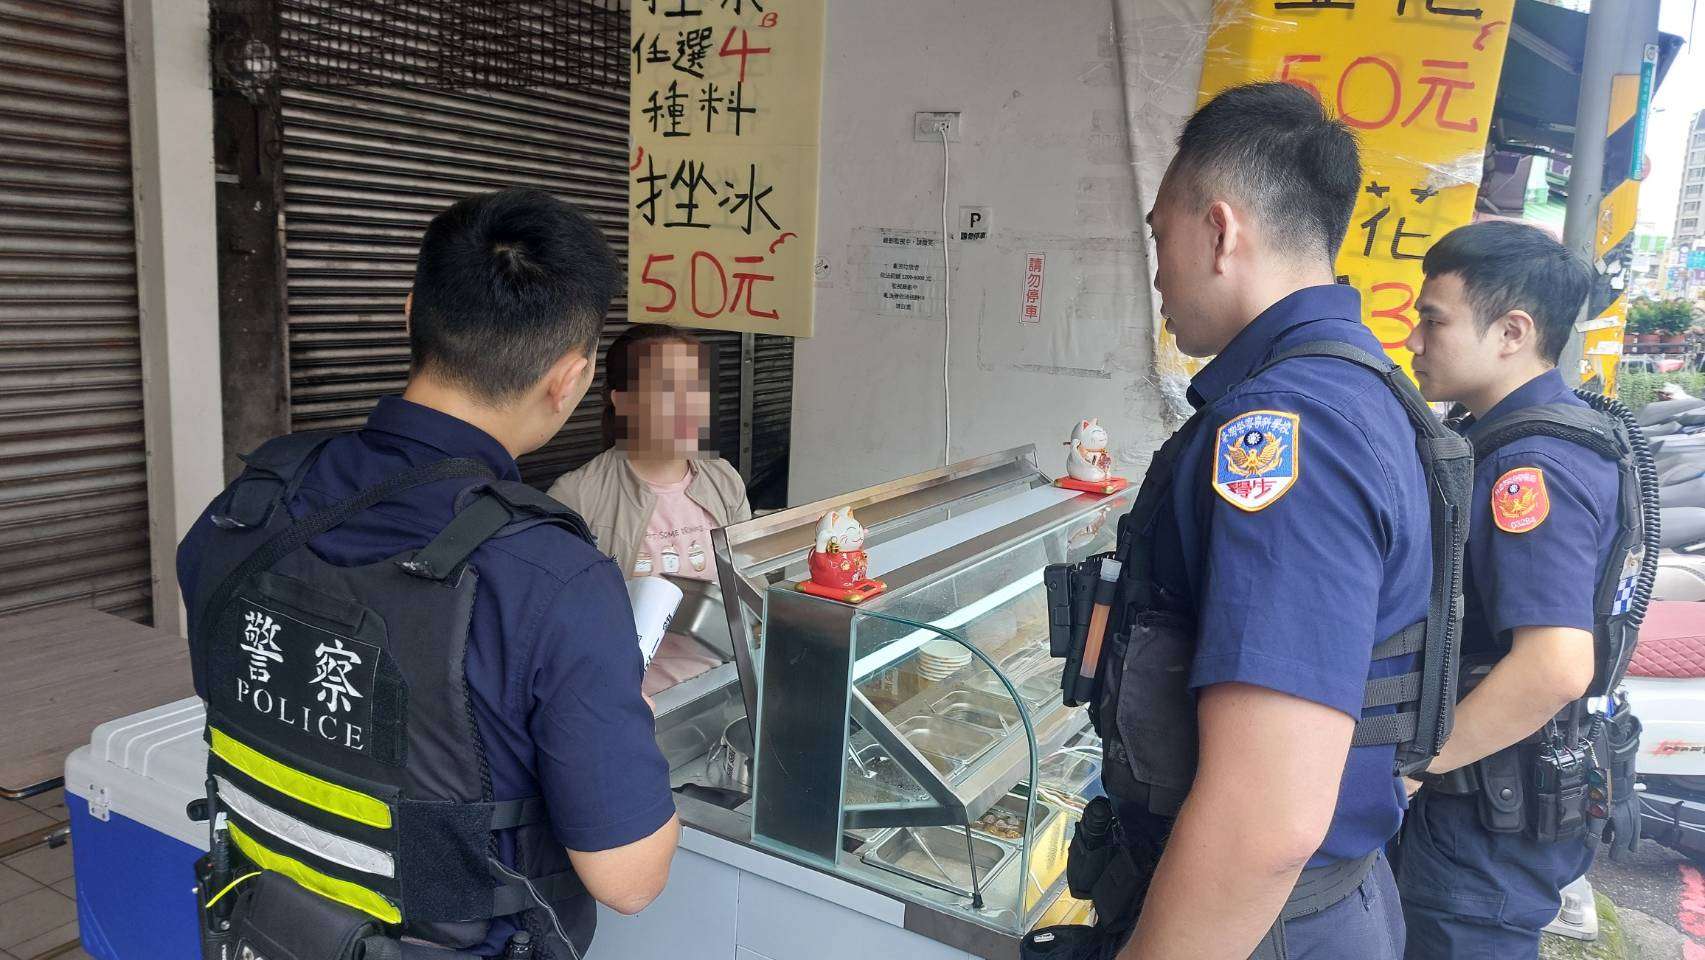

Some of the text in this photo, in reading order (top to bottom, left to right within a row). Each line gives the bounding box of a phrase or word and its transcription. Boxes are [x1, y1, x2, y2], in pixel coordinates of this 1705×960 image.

[641, 80, 757, 137] 種料
[1281, 55, 1478, 133] 50元
[970, 212, 982, 228] P
[641, 250, 780, 320] 50元
[1024, 257, 1043, 319] 請勿停車
[240, 609, 365, 715] 警察
[236, 677, 364, 751] POLICE
